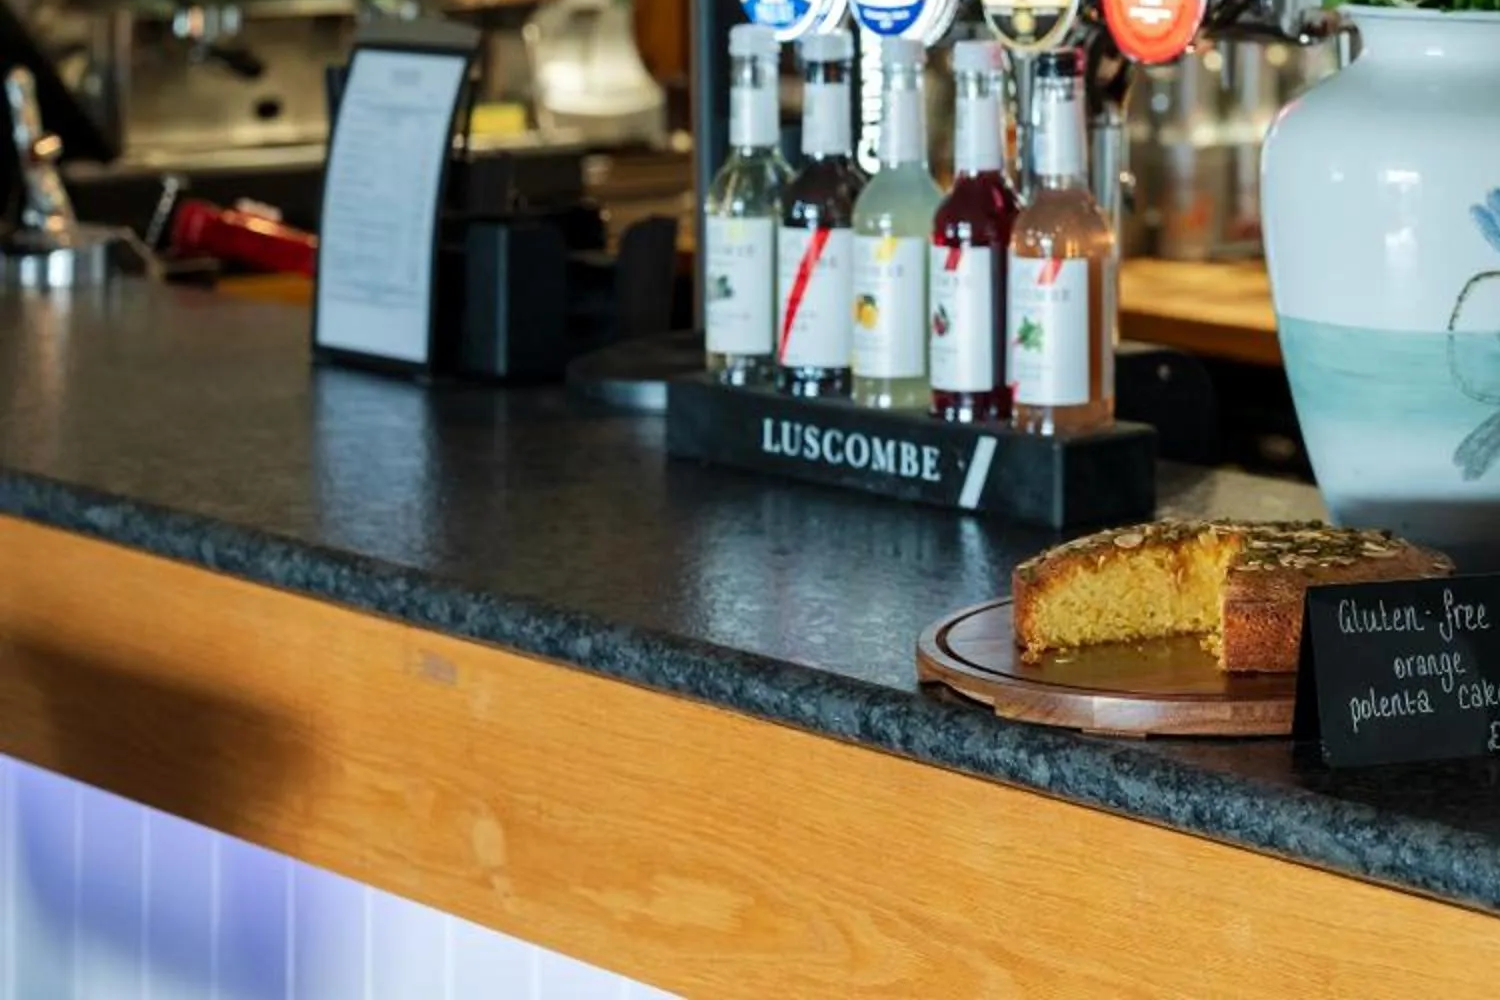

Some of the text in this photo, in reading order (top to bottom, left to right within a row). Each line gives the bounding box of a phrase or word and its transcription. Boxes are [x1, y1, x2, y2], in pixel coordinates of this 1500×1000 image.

[762, 417, 942, 482] LUSCOMBE
[1393, 650, 1466, 693] orange
[1349, 686, 1435, 733] polenta
